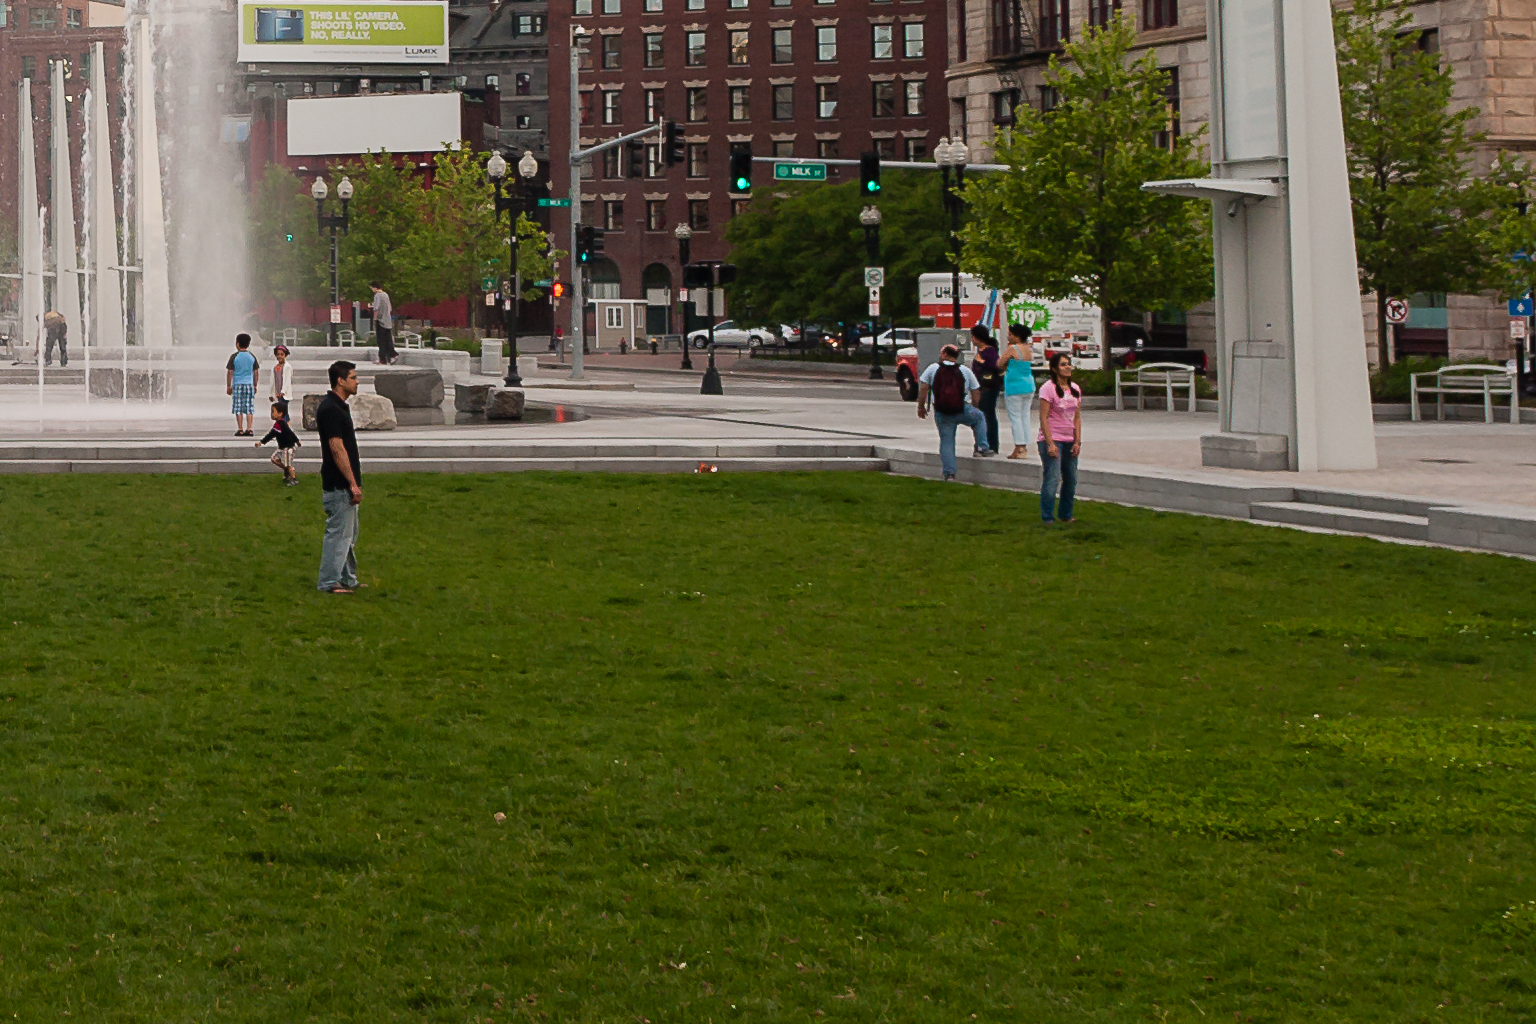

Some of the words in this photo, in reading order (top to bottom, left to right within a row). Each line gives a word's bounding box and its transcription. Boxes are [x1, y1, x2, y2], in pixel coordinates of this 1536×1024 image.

[309, 11, 333, 20] THIS
[354, 11, 399, 21] CAMERA
[310, 21, 353, 30] SHOOTS
[355, 22, 371, 30] HD
[372, 21, 407, 31] VIDEO.
[310, 31, 329, 41] NO,
[331, 31, 371, 40] REALLY.
[405, 47, 438, 55] LUMIX
[792, 167, 811, 175] MILK
